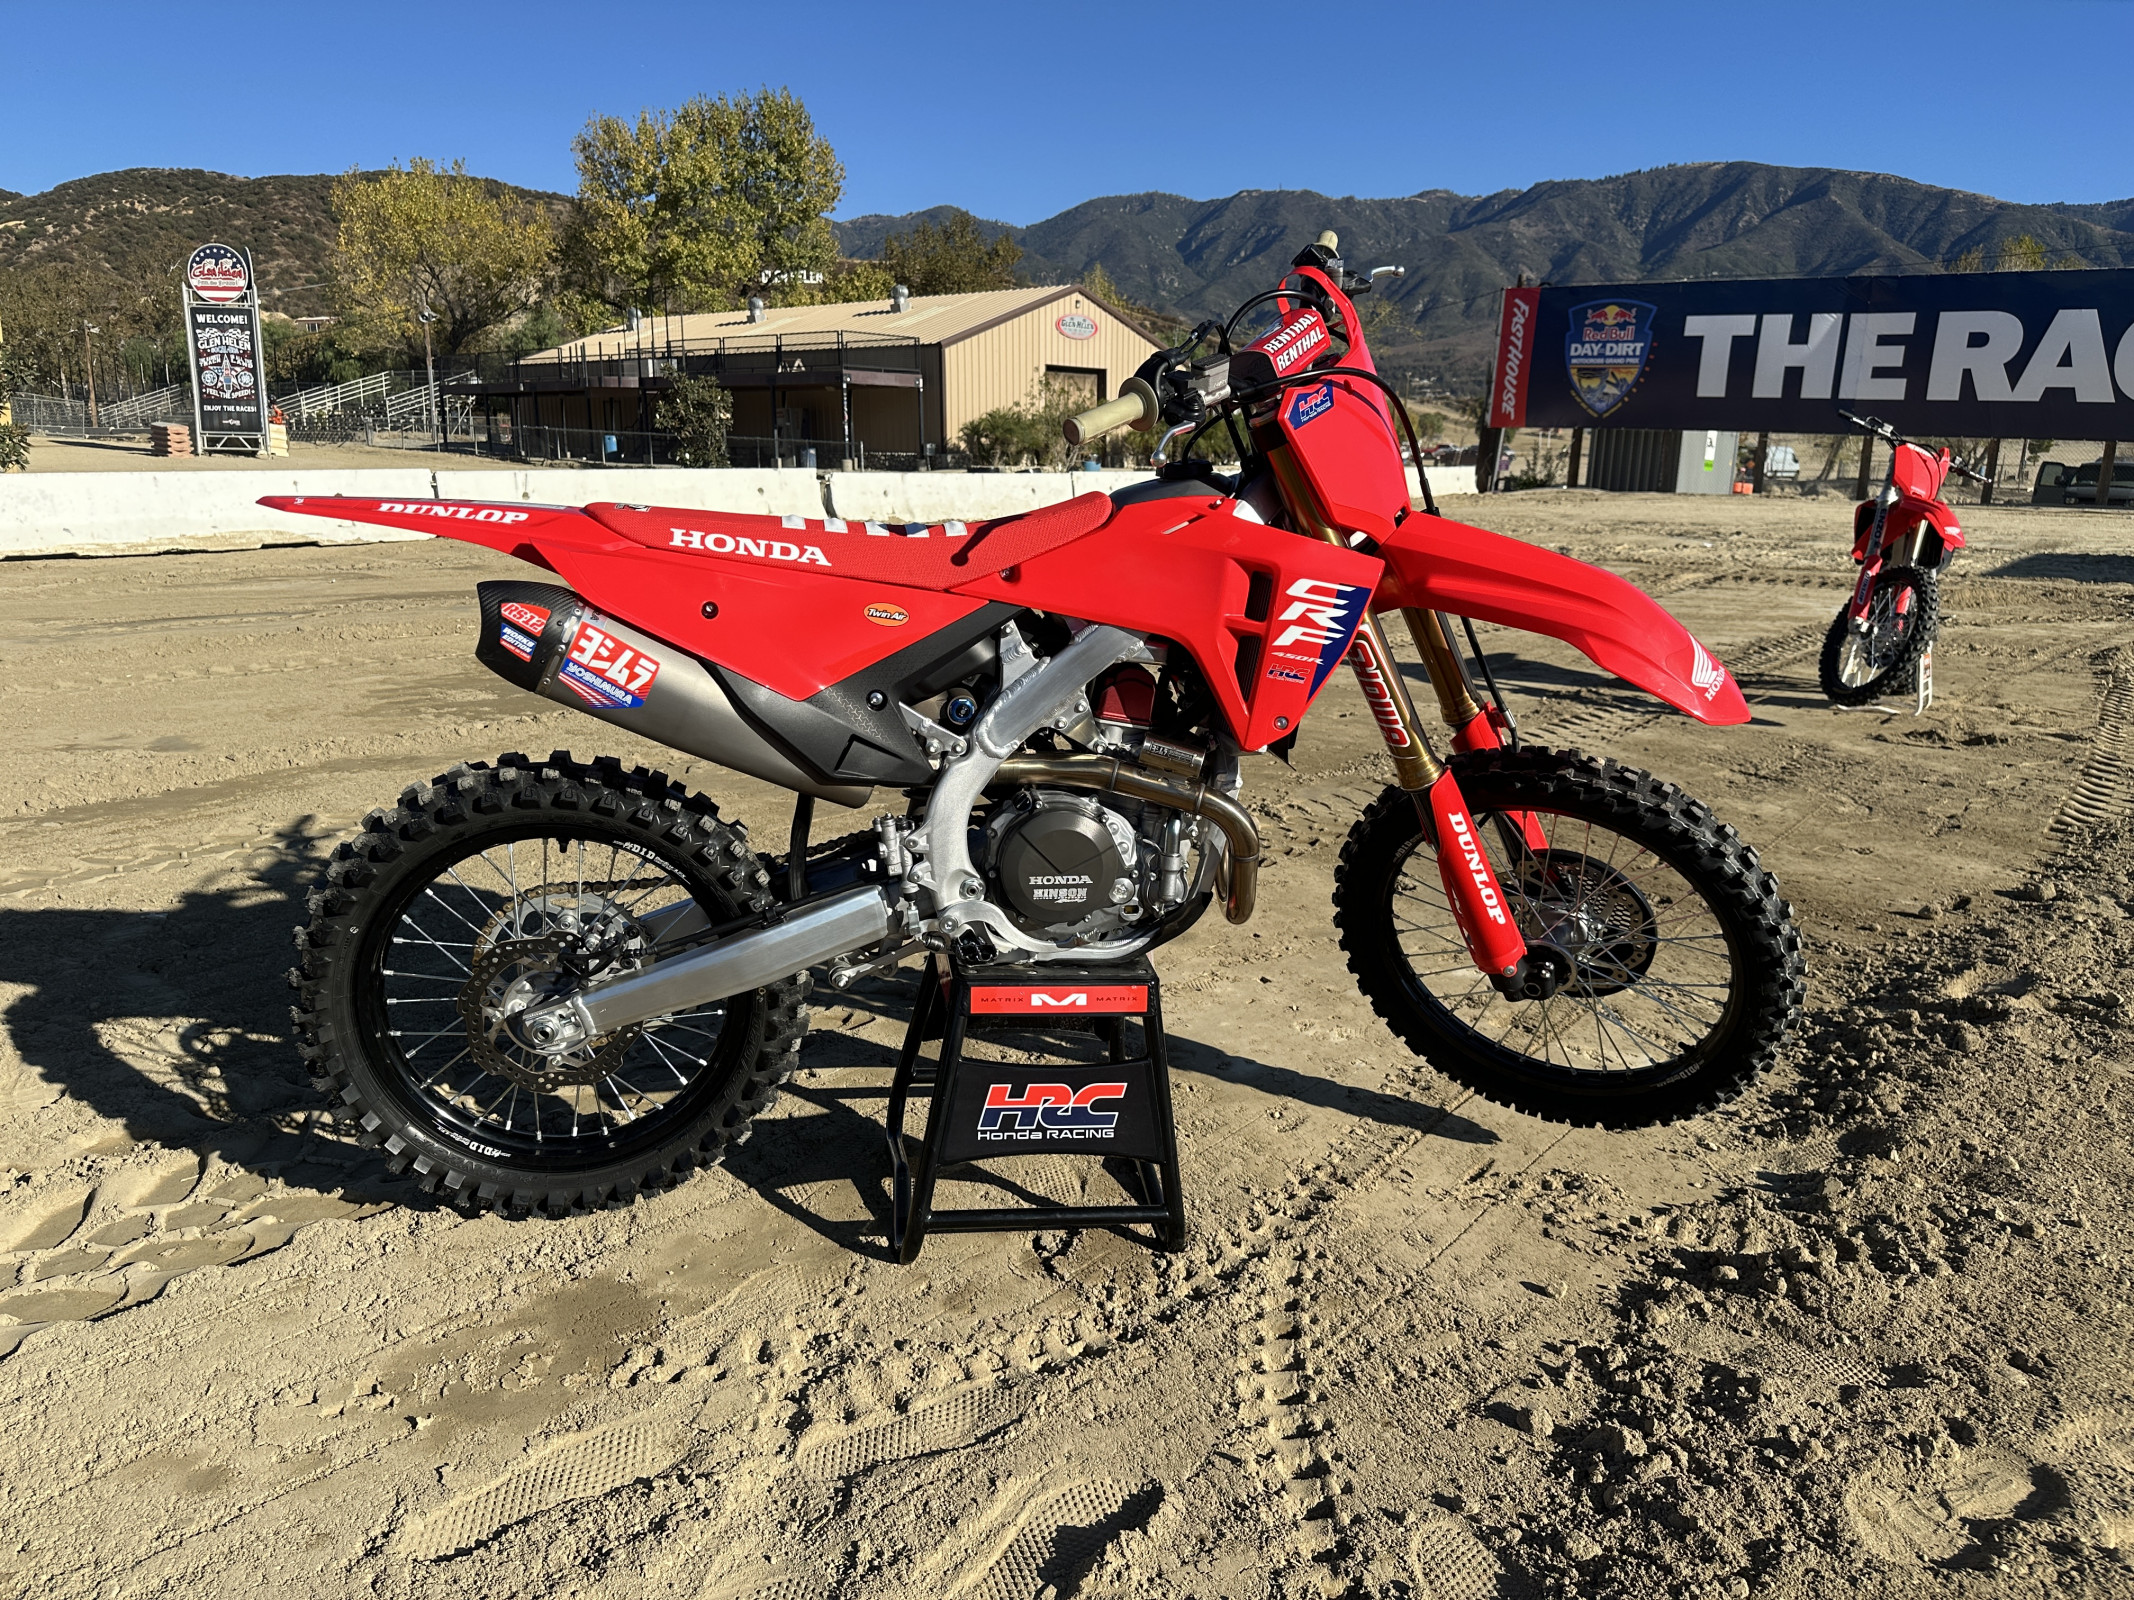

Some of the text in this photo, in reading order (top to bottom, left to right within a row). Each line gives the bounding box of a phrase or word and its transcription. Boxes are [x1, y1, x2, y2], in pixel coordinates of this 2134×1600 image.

[195, 313, 248, 325] WELCOME!
[198, 335, 221, 349] GLEN
[221, 335, 252, 351] HELEN
[1263, 313, 1317, 354] RENTHAL
[1582, 325, 1636, 341] Red Bull
[1276, 326, 1325, 372] RENTHAL
[1501, 298, 1530, 420] FASTHOUSE
[1570, 343, 1602, 356] DAY
[1605, 342, 1645, 356] DIRT
[1683, 309, 2134, 403] THE RA
[206, 388, 220, 397] FEEL
[219, 390, 231, 399] THE
[1298, 387, 1330, 419] HRC
[376, 502, 529, 524] DUNLOP
[669, 528, 832, 567] HONDA
[868, 608, 907, 621] Twin Air
[1272, 578, 1357, 646] CRF
[501, 634, 533, 653] EDITION
[502, 627, 535, 648] WORKS
[570, 627, 657, 692] ヨシムラ
[1271, 651, 1325, 665] 450R
[566, 661, 633, 704] YOSHIMURA
[1267, 663, 1310, 681] HRC
[1448, 812, 1506, 925] DUNLOP
[1029, 875, 1093, 885] HONDA
[1033, 888, 1087, 899] HINSON
[977, 1083, 1128, 1130] HRC
[977, 1129, 1114, 1140] Honda RACING
